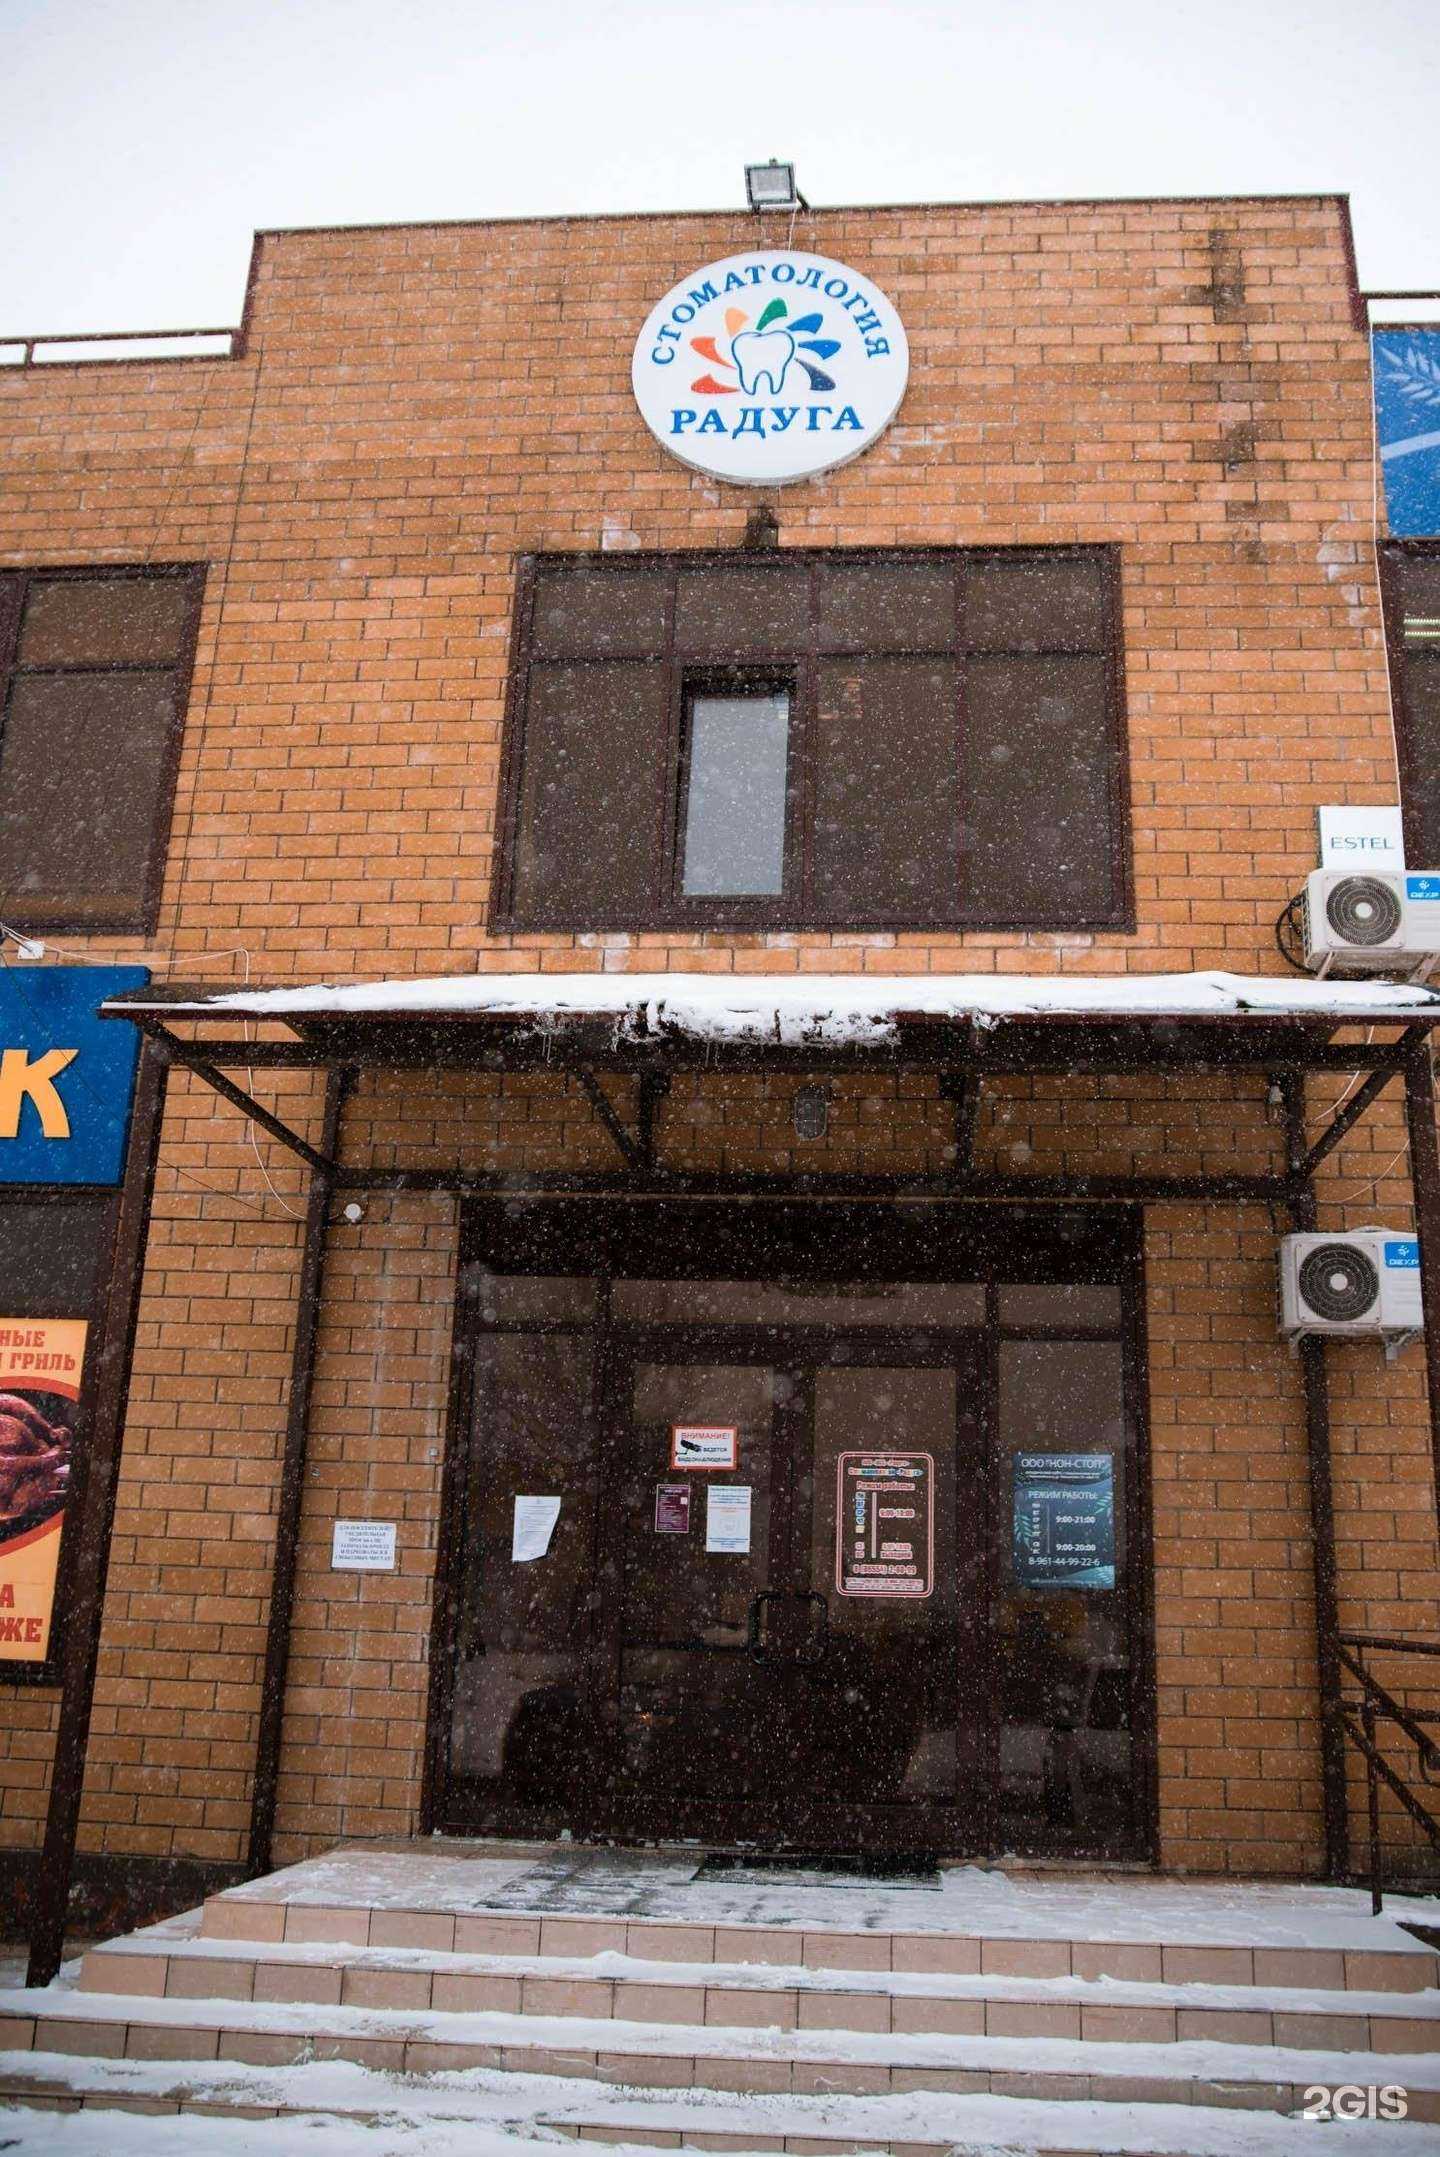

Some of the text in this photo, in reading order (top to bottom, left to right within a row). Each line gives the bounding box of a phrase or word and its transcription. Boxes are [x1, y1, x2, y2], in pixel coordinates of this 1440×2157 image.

[651, 263, 891, 365] СТОМАТОЛОГИЯ
[670, 405, 865, 440] РАДУГА
[1331, 836, 1395, 849] ESTEL
[9, 1352, 76, 1371] ГРИЛЬ
[681, 1432, 730, 1440] ВНИМАНИЕ!
[1021, 1458, 1045, 1468] ООО
[1028, 1490, 1060, 1500] РЕЖИМ
